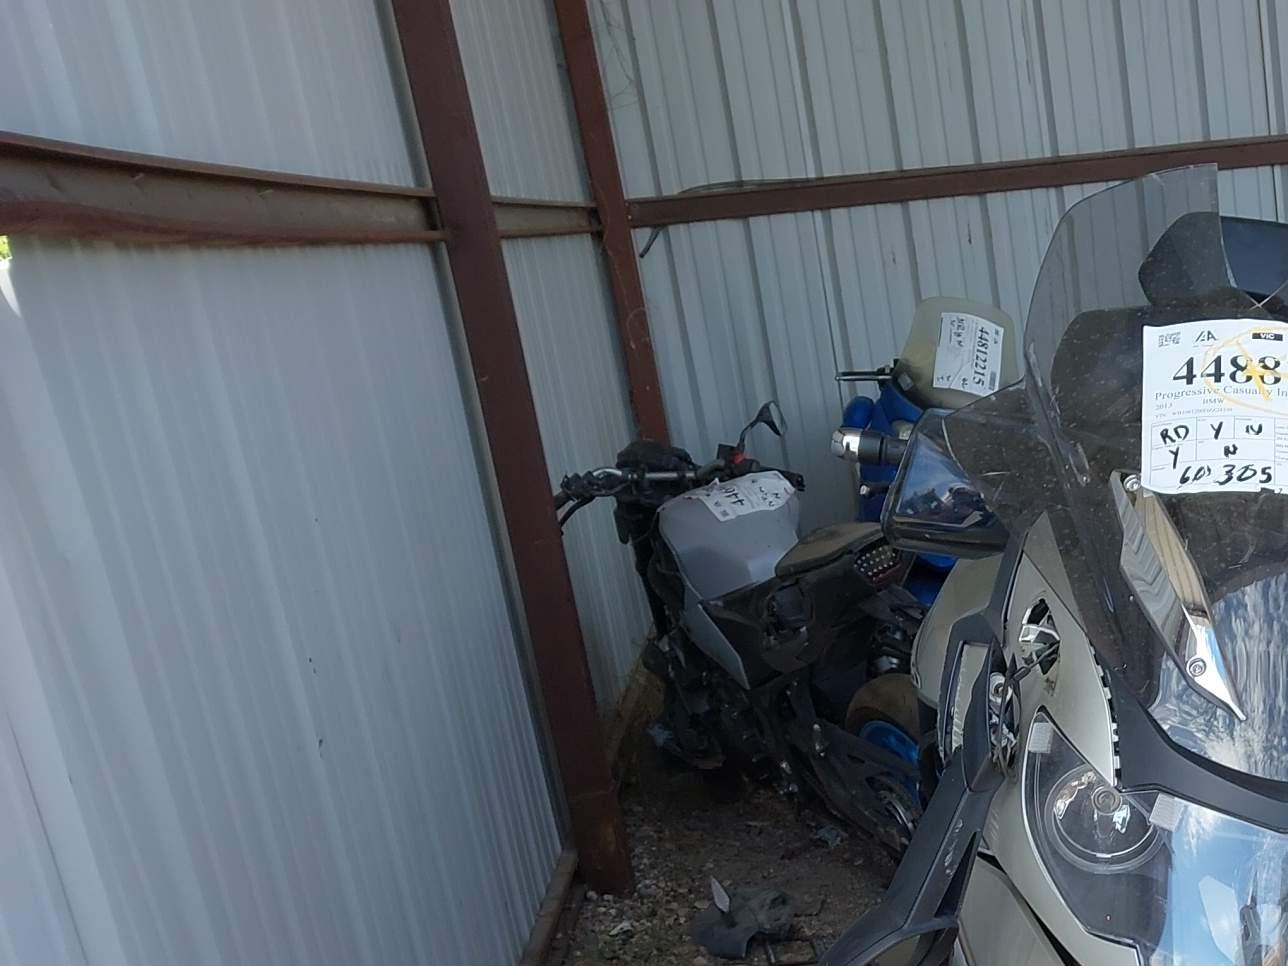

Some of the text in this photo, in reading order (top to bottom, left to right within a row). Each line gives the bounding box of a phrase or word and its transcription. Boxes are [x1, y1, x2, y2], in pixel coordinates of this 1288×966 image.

[973, 327, 989, 386] 44812215
[1155, 385, 1220, 401] Progressive
[1160, 425, 1189, 445] RD
[1210, 421, 1223, 440] Y
[1168, 446, 1180, 470] Y
